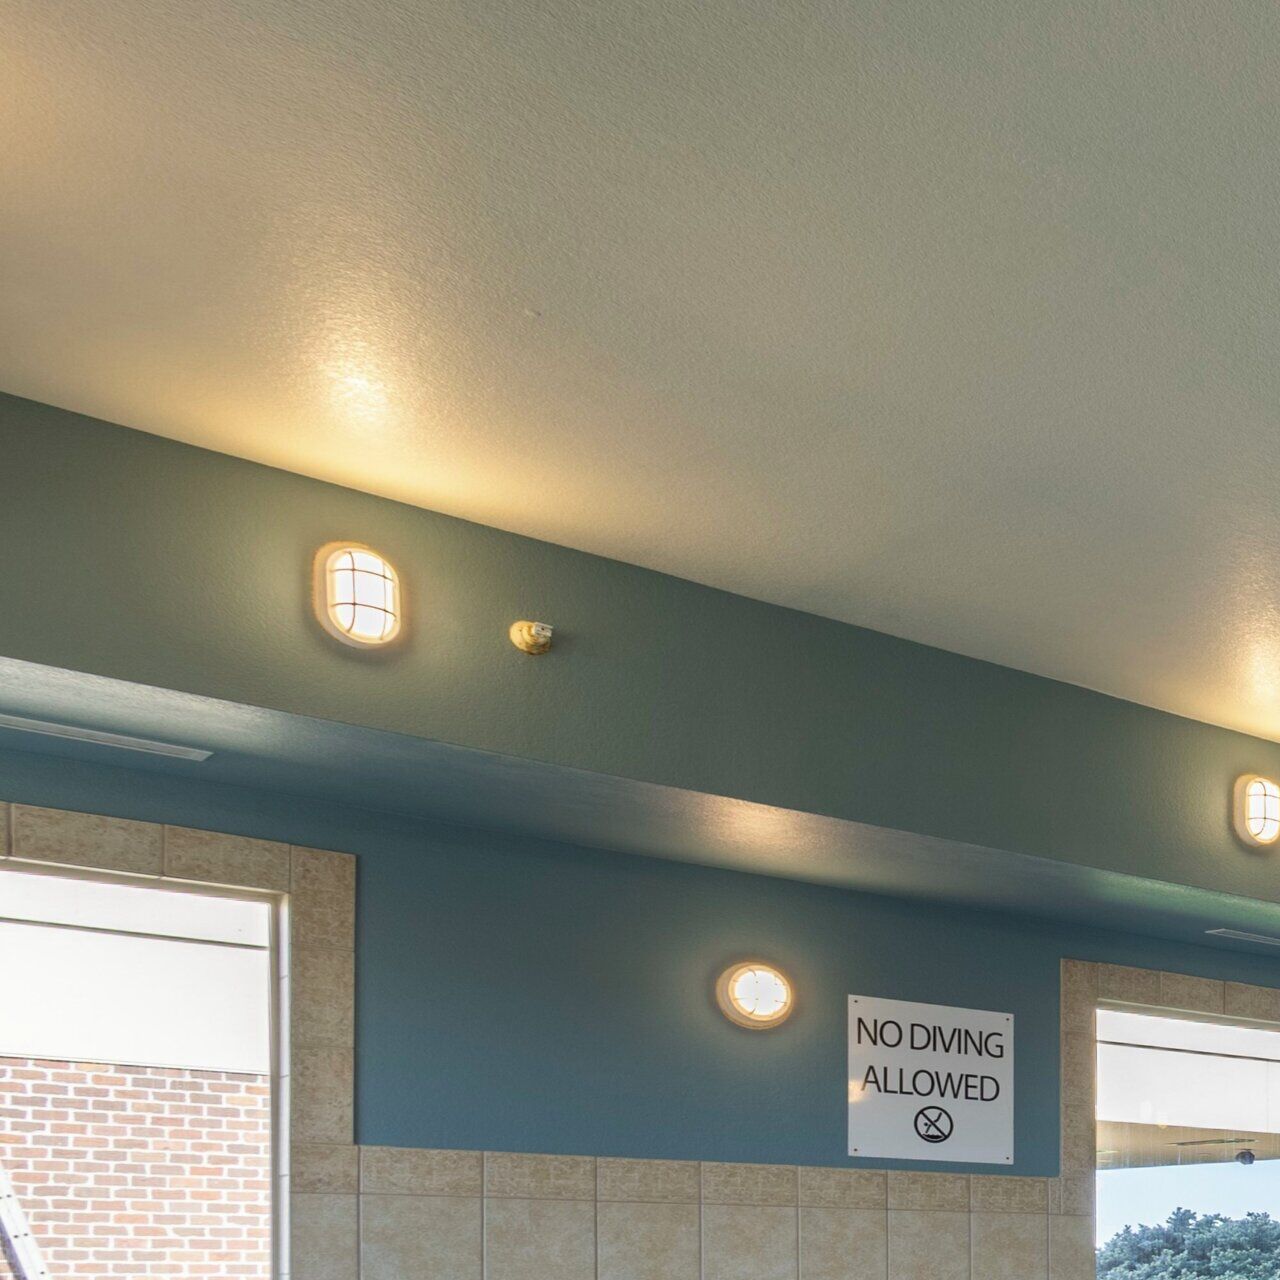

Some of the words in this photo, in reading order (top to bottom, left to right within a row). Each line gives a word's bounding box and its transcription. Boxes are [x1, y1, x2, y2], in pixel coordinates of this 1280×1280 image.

[857, 1017, 903, 1048] NO
[910, 1023, 1004, 1058] DIVING
[861, 1065, 1000, 1101] ALLOWED
